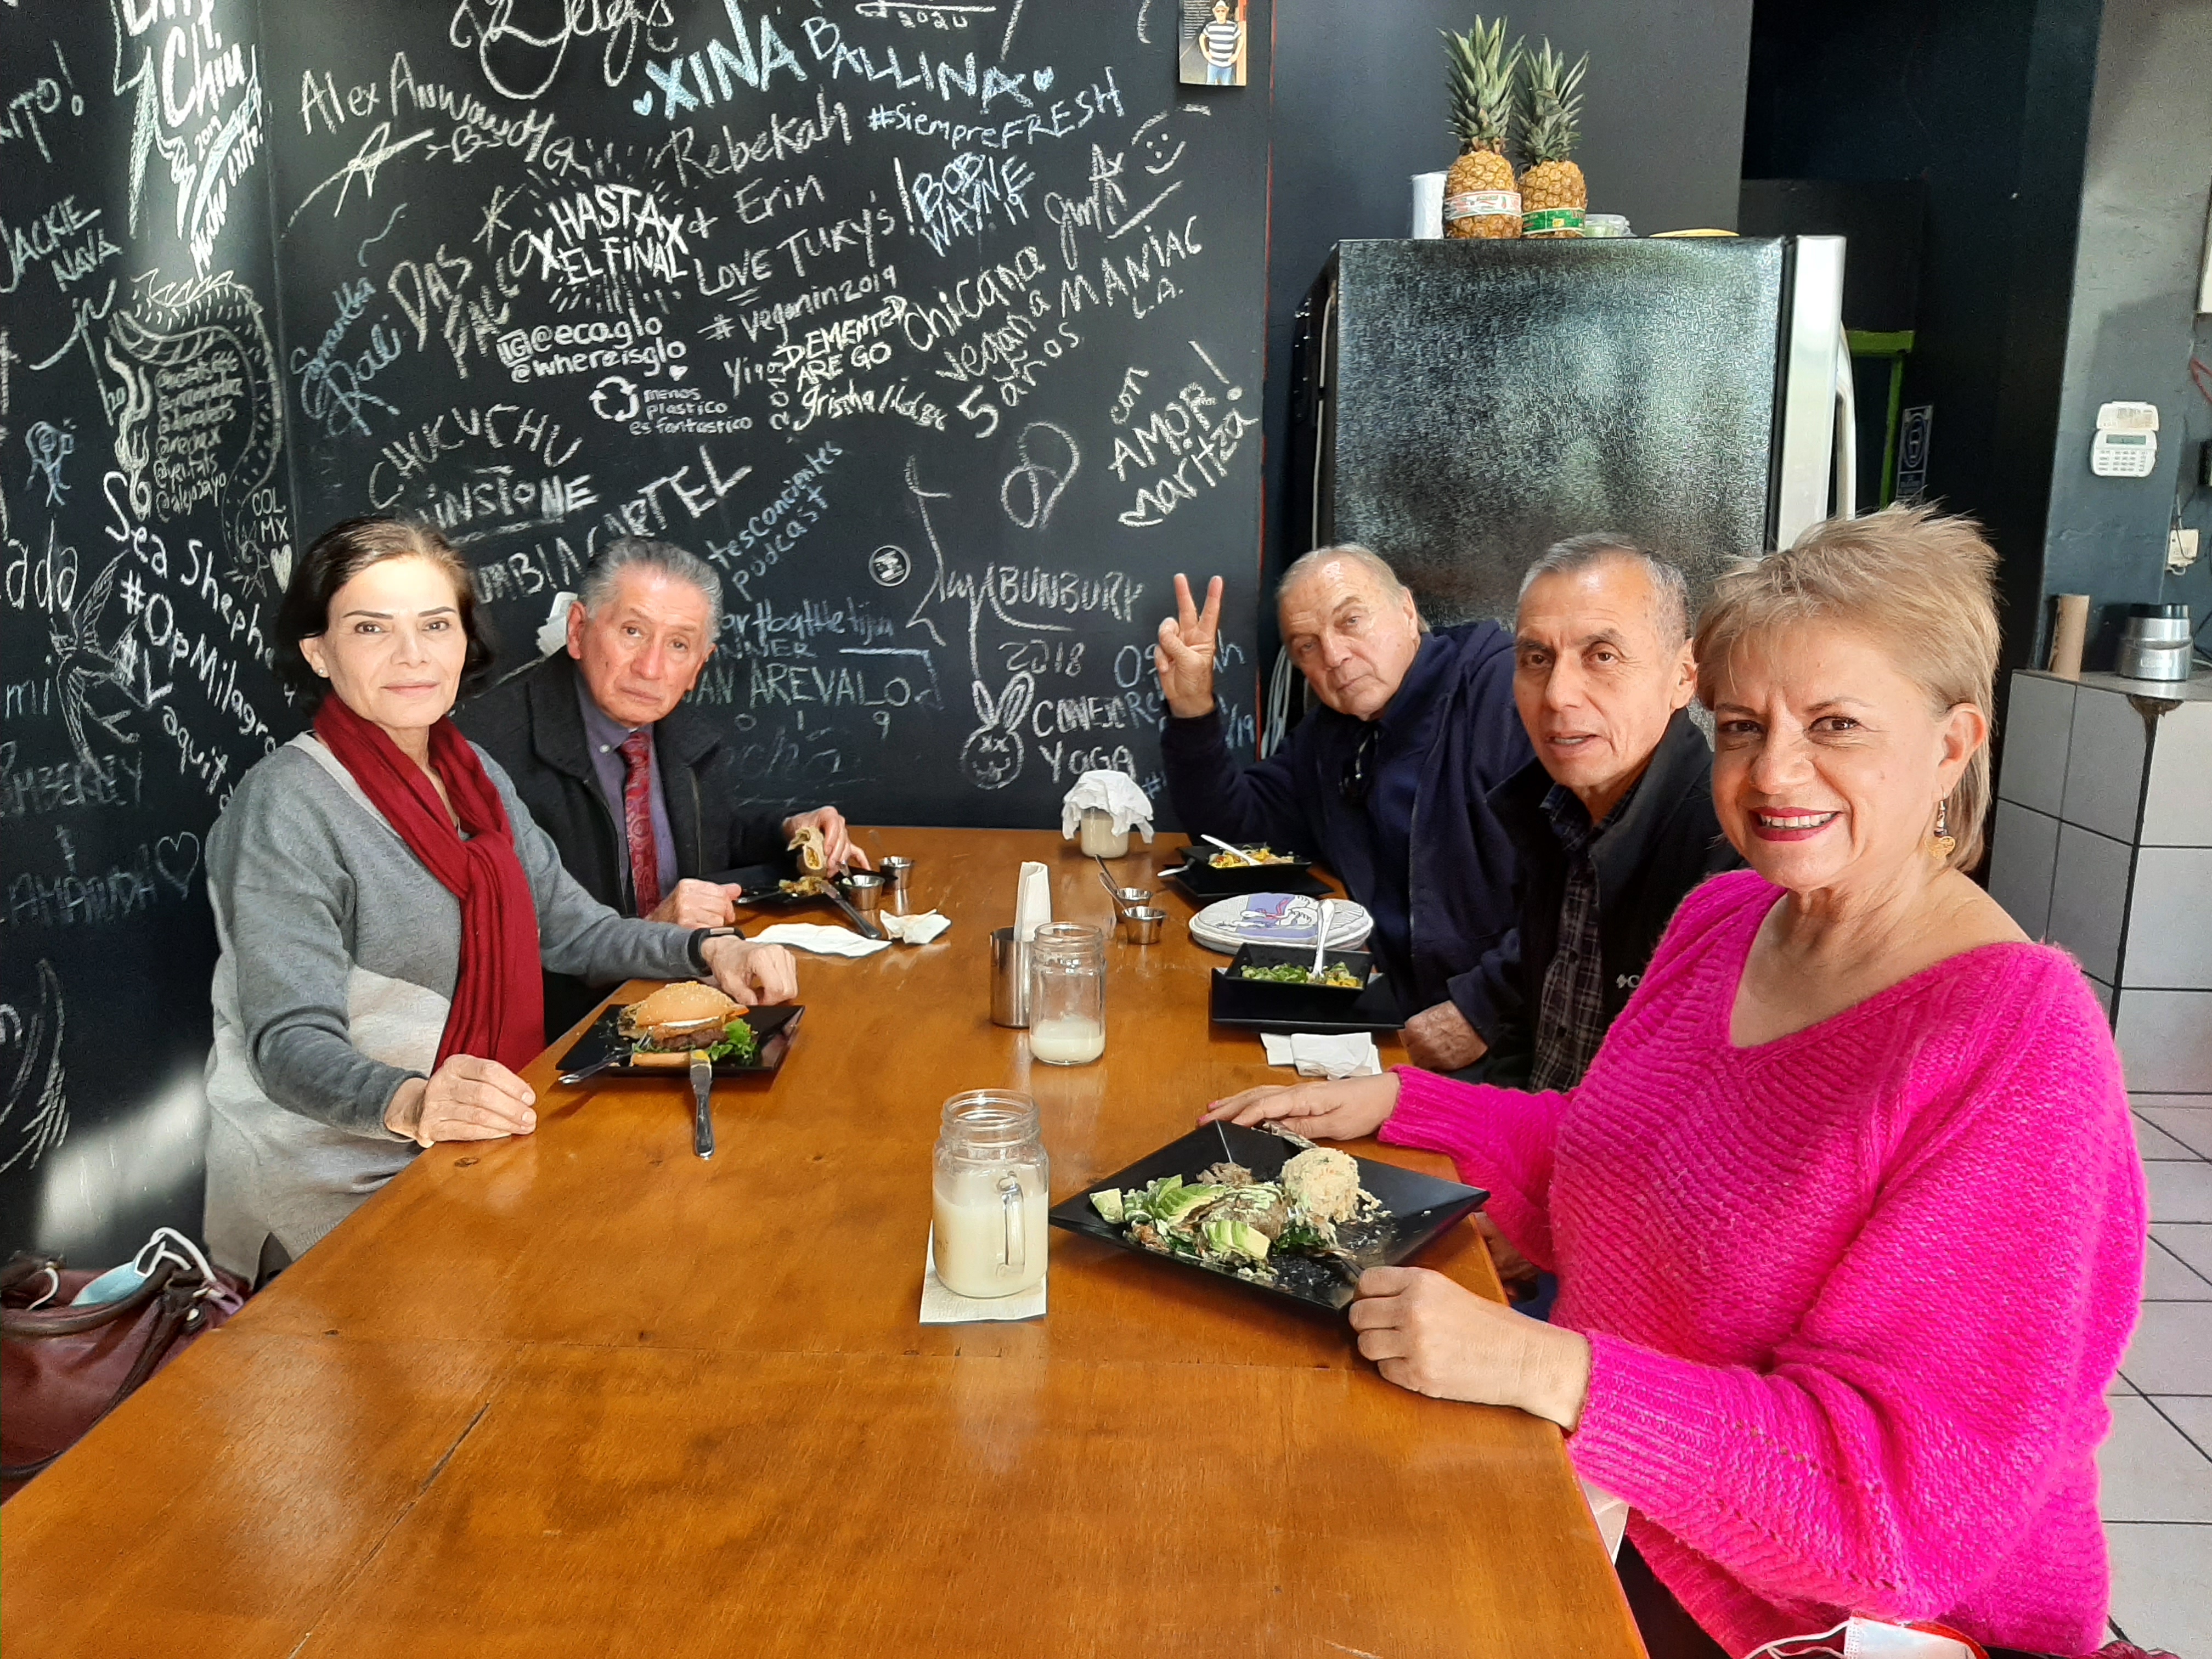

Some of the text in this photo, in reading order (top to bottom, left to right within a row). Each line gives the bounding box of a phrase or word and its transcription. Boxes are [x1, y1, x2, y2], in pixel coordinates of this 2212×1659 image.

[645, 0, 809, 121] XINA
[301, 70, 382, 135] Alex
[652, 83, 853, 187] Rebekah
[733, 174, 825, 224] Erin
[692, 248, 772, 296] LOVE
[904, 246, 1046, 352] Chicana
[850, 341, 893, 371] GO
[643, 387, 702, 403] menos
[956, 386, 999, 439] 5
[629, 420, 653, 436] es
[1118, 408, 1259, 528] Maritza
[998, 565, 1146, 623] BUNBURY
[749, 658, 912, 709] AREVALO
